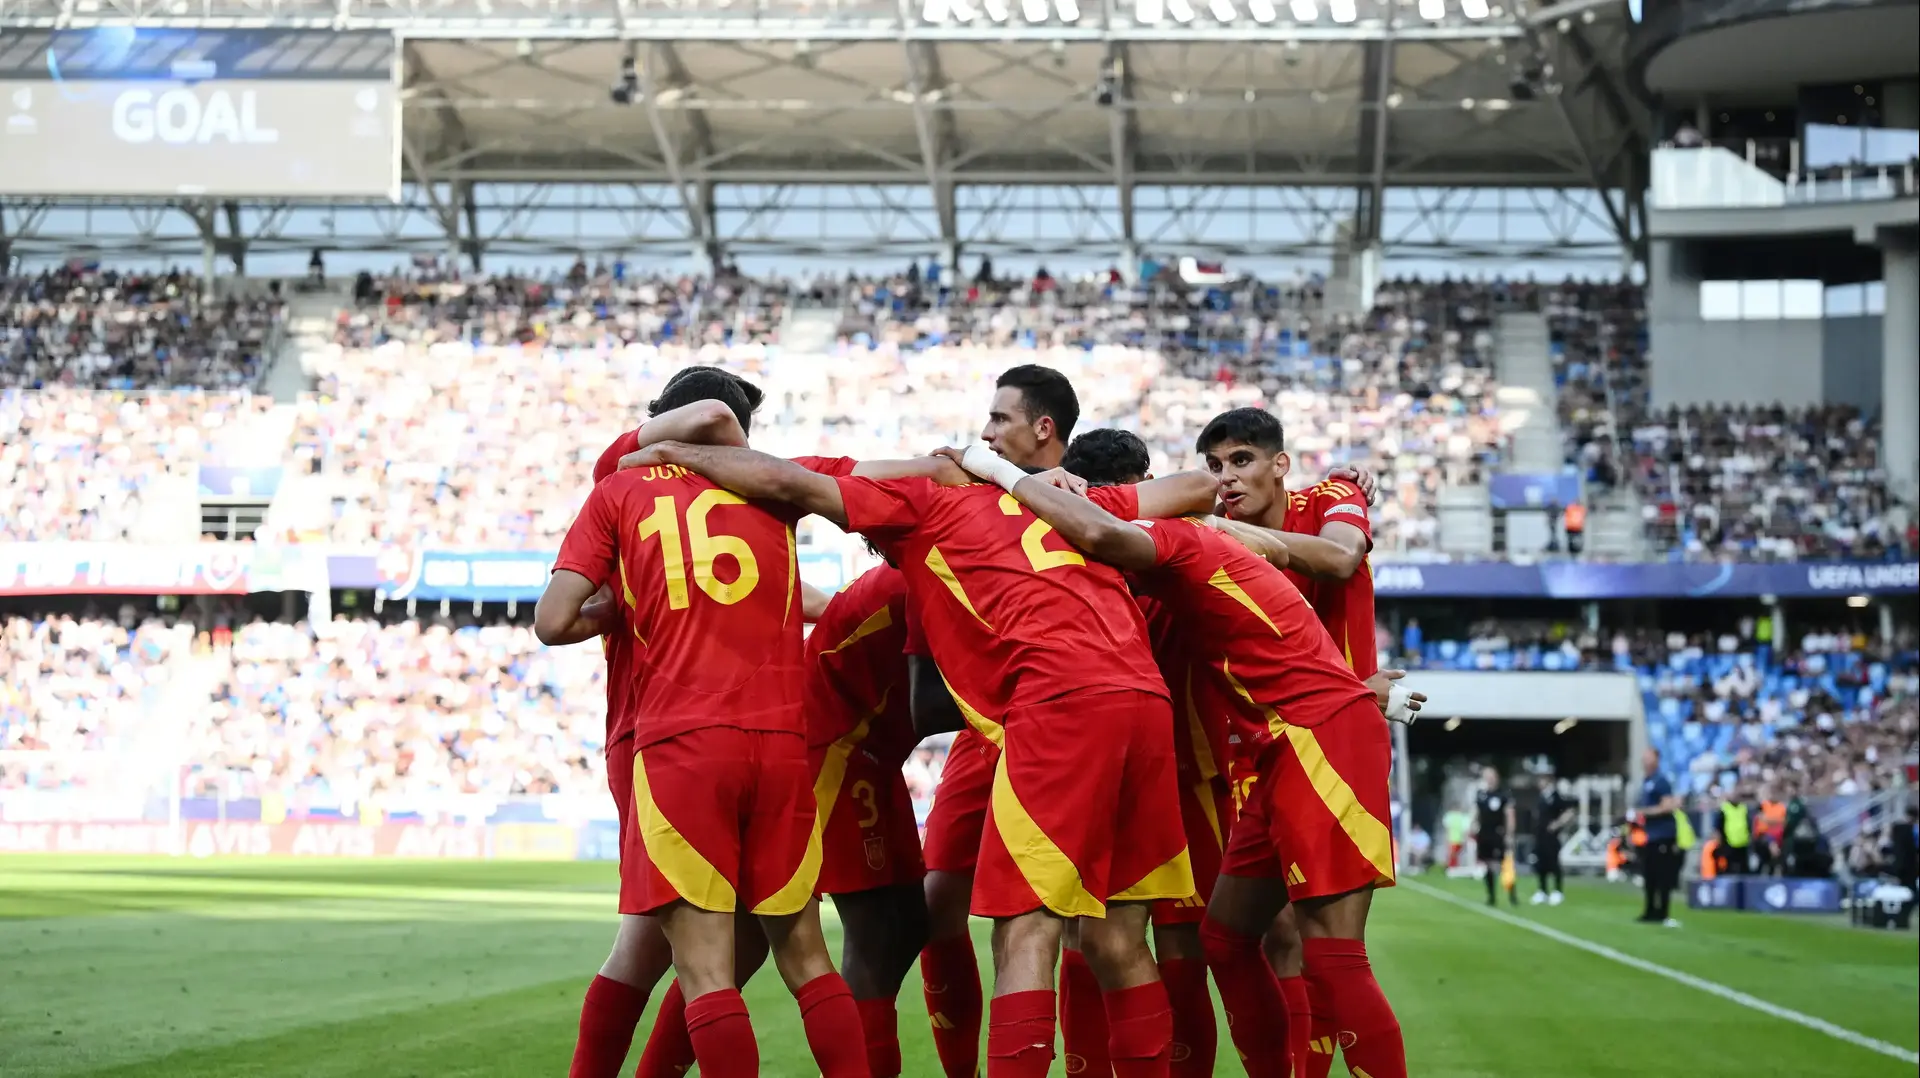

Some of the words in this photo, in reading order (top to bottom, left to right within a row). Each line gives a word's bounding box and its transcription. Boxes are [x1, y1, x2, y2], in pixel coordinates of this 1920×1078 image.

[113, 90, 279, 144] GOAL
[638, 489, 759, 610] 16
[998, 493, 1087, 573] 2
[1808, 565, 1864, 589] UEFA
[852, 780, 879, 827] 3
[190, 823, 271, 856] AVIS
[291, 823, 374, 856] AVIS
[395, 823, 477, 856] AVIS
